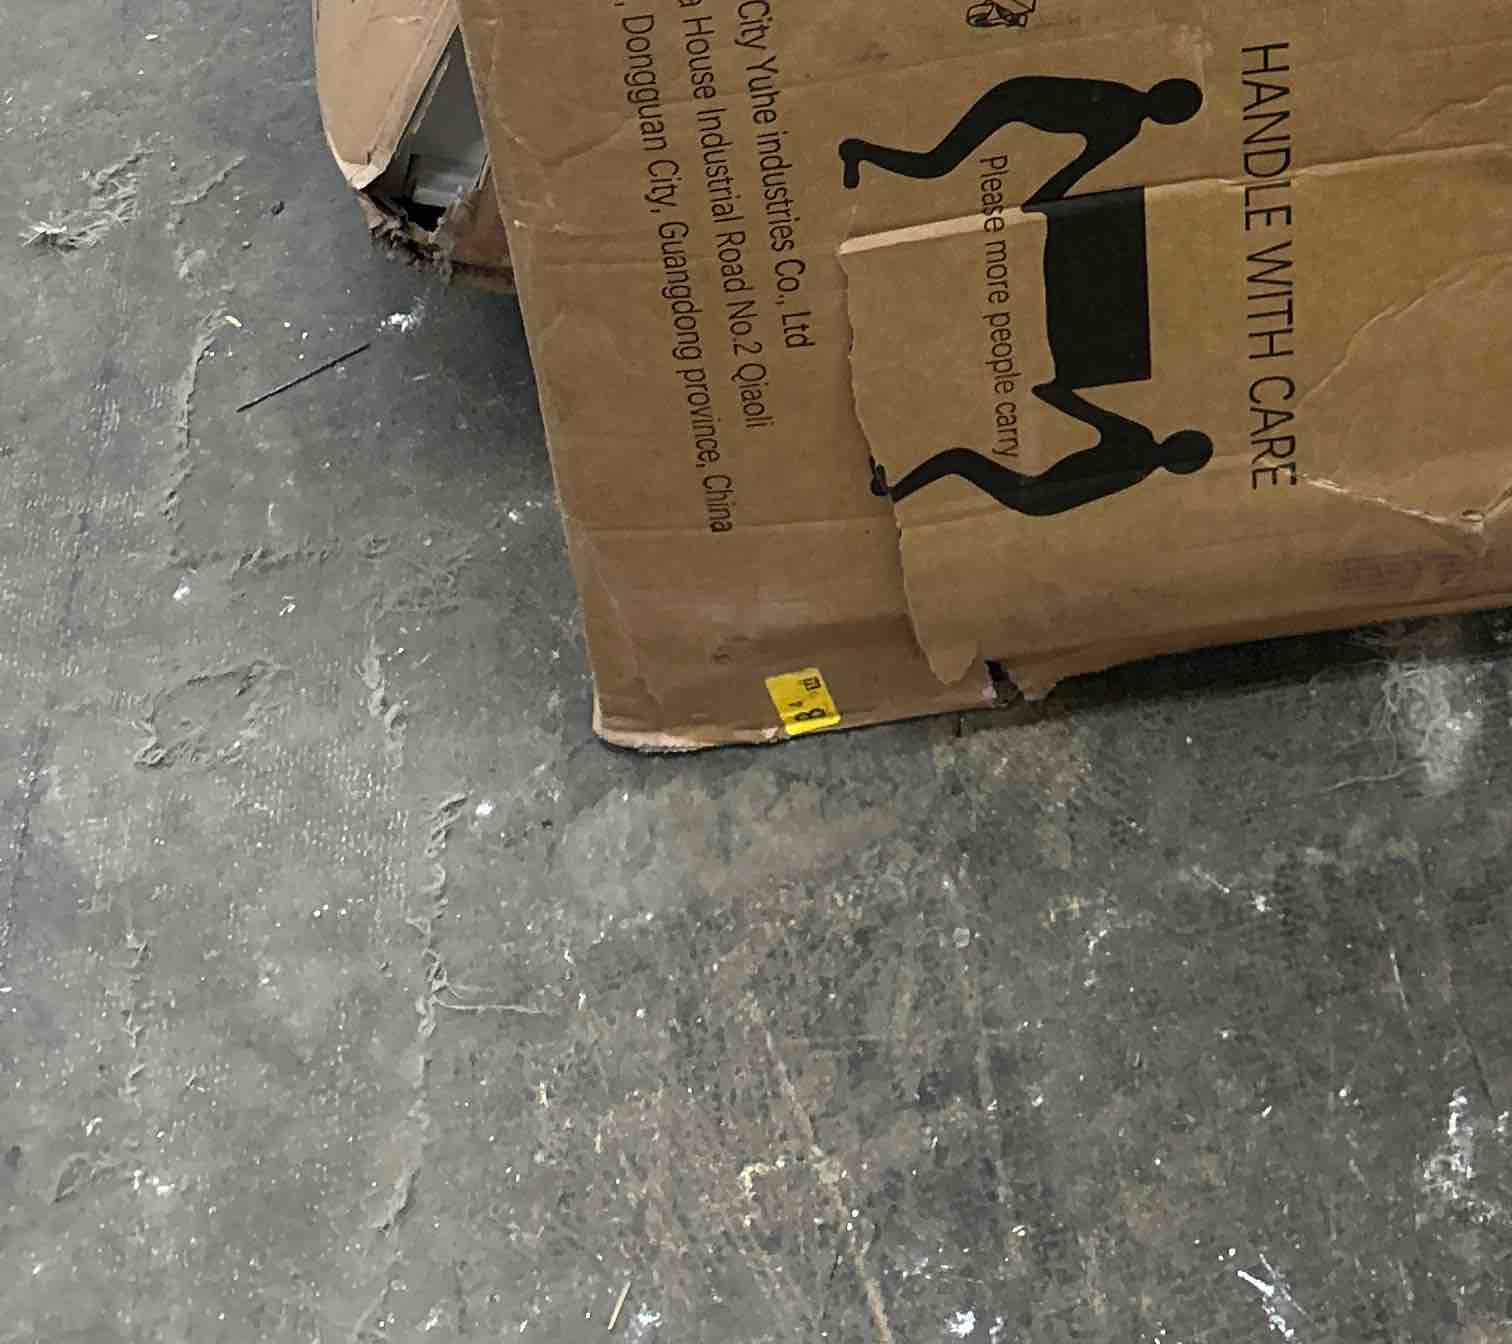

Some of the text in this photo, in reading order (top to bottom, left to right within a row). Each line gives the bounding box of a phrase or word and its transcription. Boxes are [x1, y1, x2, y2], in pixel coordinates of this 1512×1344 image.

[682, 16, 717, 100] House
[734, 0, 773, 51] City
[622, 14, 668, 151] Dongguan
[746, 55, 781, 125] Yuhe
[644, 159, 684, 213] City,
[696, 108, 747, 224] Industrial
[756, 131, 801, 253] industries
[658, 221, 704, 361] Guangdong
[715, 231, 754, 293] Road
[774, 259, 806, 305] Co.,
[1241, 42, 1298, 490] HANDLE WITH CARE
[725, 300, 764, 356] No.2
[781, 310, 817, 349] Ltd
[979, 153, 1023, 459] Please more people carry
[675, 367, 722, 468] province,
[731, 362, 776, 429] Qiaoli
[701, 474, 737, 533] China
